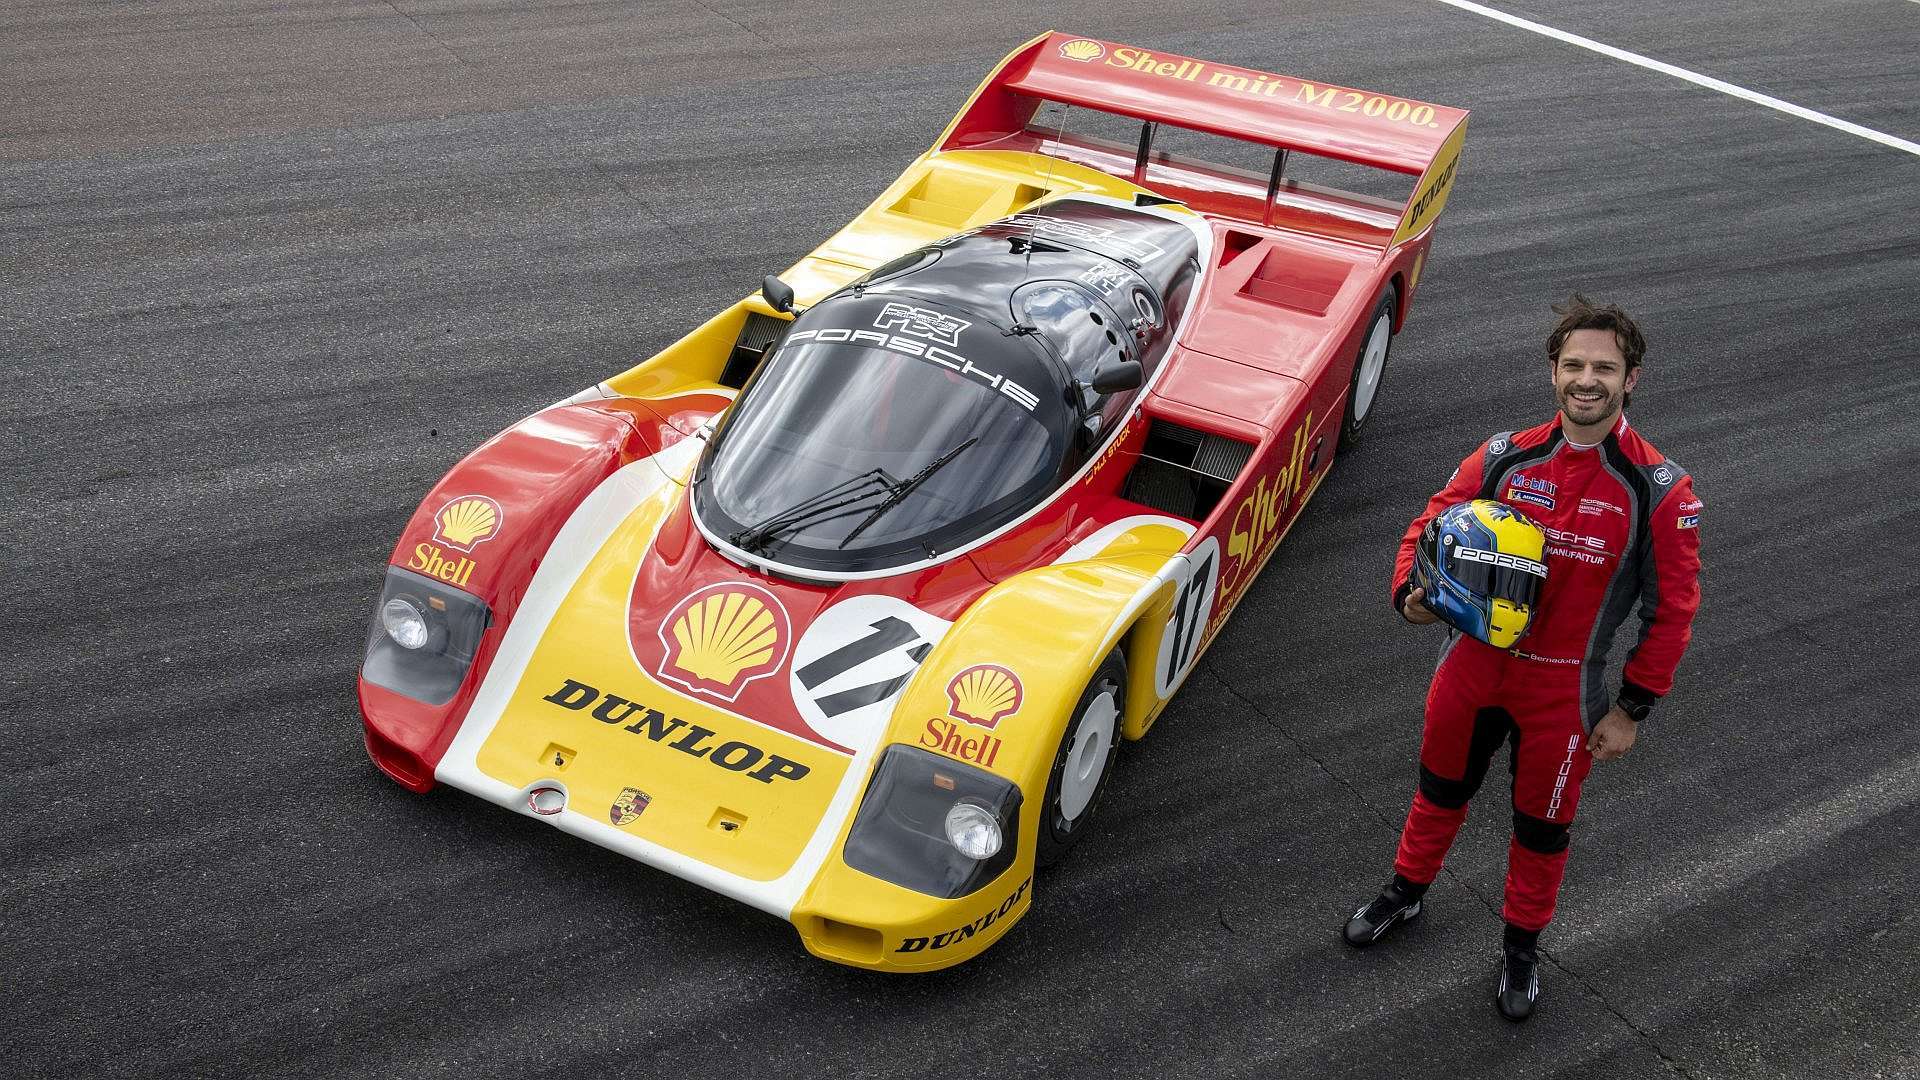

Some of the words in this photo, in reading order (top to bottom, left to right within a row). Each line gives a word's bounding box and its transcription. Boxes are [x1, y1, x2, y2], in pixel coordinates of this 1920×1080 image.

[1105, 46, 1205, 84] Shell
[1211, 70, 1286, 99] mit
[1292, 83, 1442, 129] M2000.
[1408, 152, 1460, 230] DUNLOP
[784, 327, 1041, 412] PORSCHE
[1108, 424, 1131, 458] STUCK
[1218, 410, 1313, 605] Shell
[1510, 473, 1547, 492] Mobil
[1522, 493, 1551, 506] MICHELIN
[407, 543, 478, 588] Shell
[1531, 518, 1606, 549] RSCHE
[1165, 549, 1215, 690] 17
[795, 616, 934, 719] 17
[543, 678, 812, 785] DUNLOP
[919, 717, 1003, 769] Shell
[1546, 734, 1581, 819] PORSCHE
[894, 874, 1032, 953] DUNLOP
